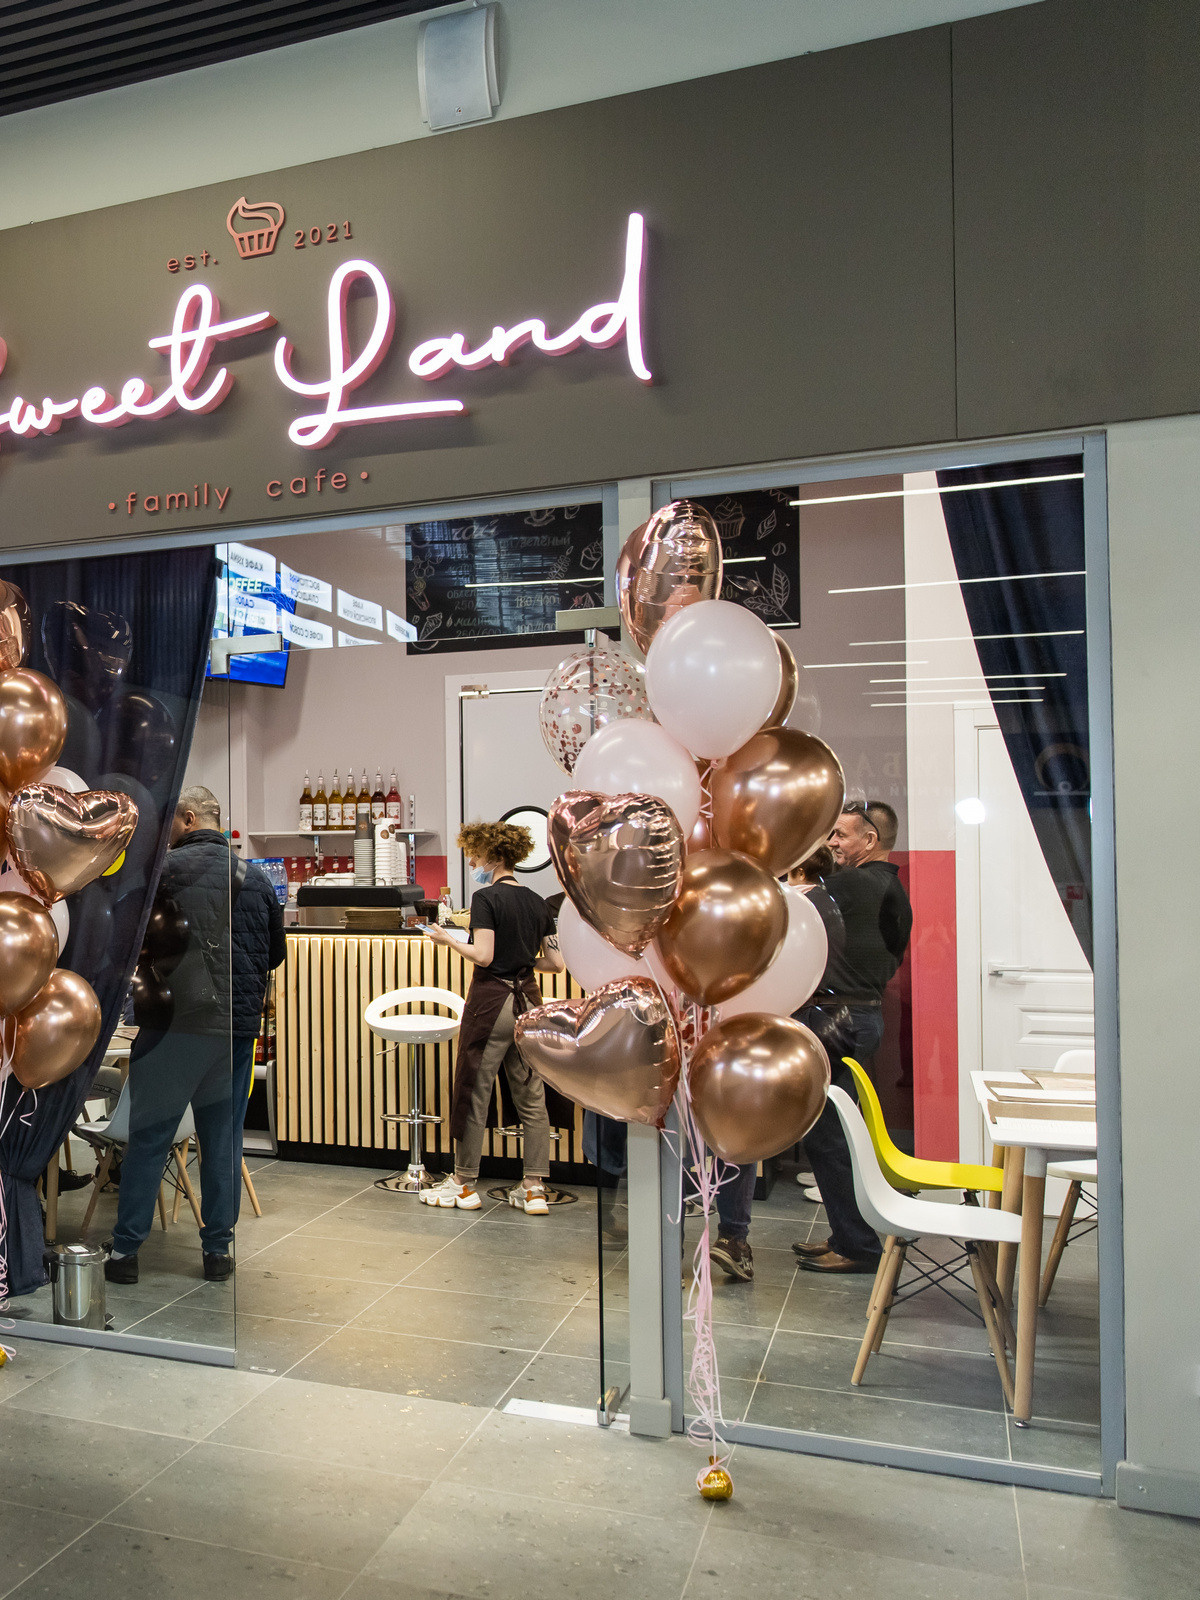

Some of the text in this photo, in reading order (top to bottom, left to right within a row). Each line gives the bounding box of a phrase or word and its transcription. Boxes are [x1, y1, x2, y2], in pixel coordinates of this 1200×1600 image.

[166, 220, 354, 273] est. 2021
[274, 212, 653, 449] Land
[125, 468, 348, 514] family cafe
